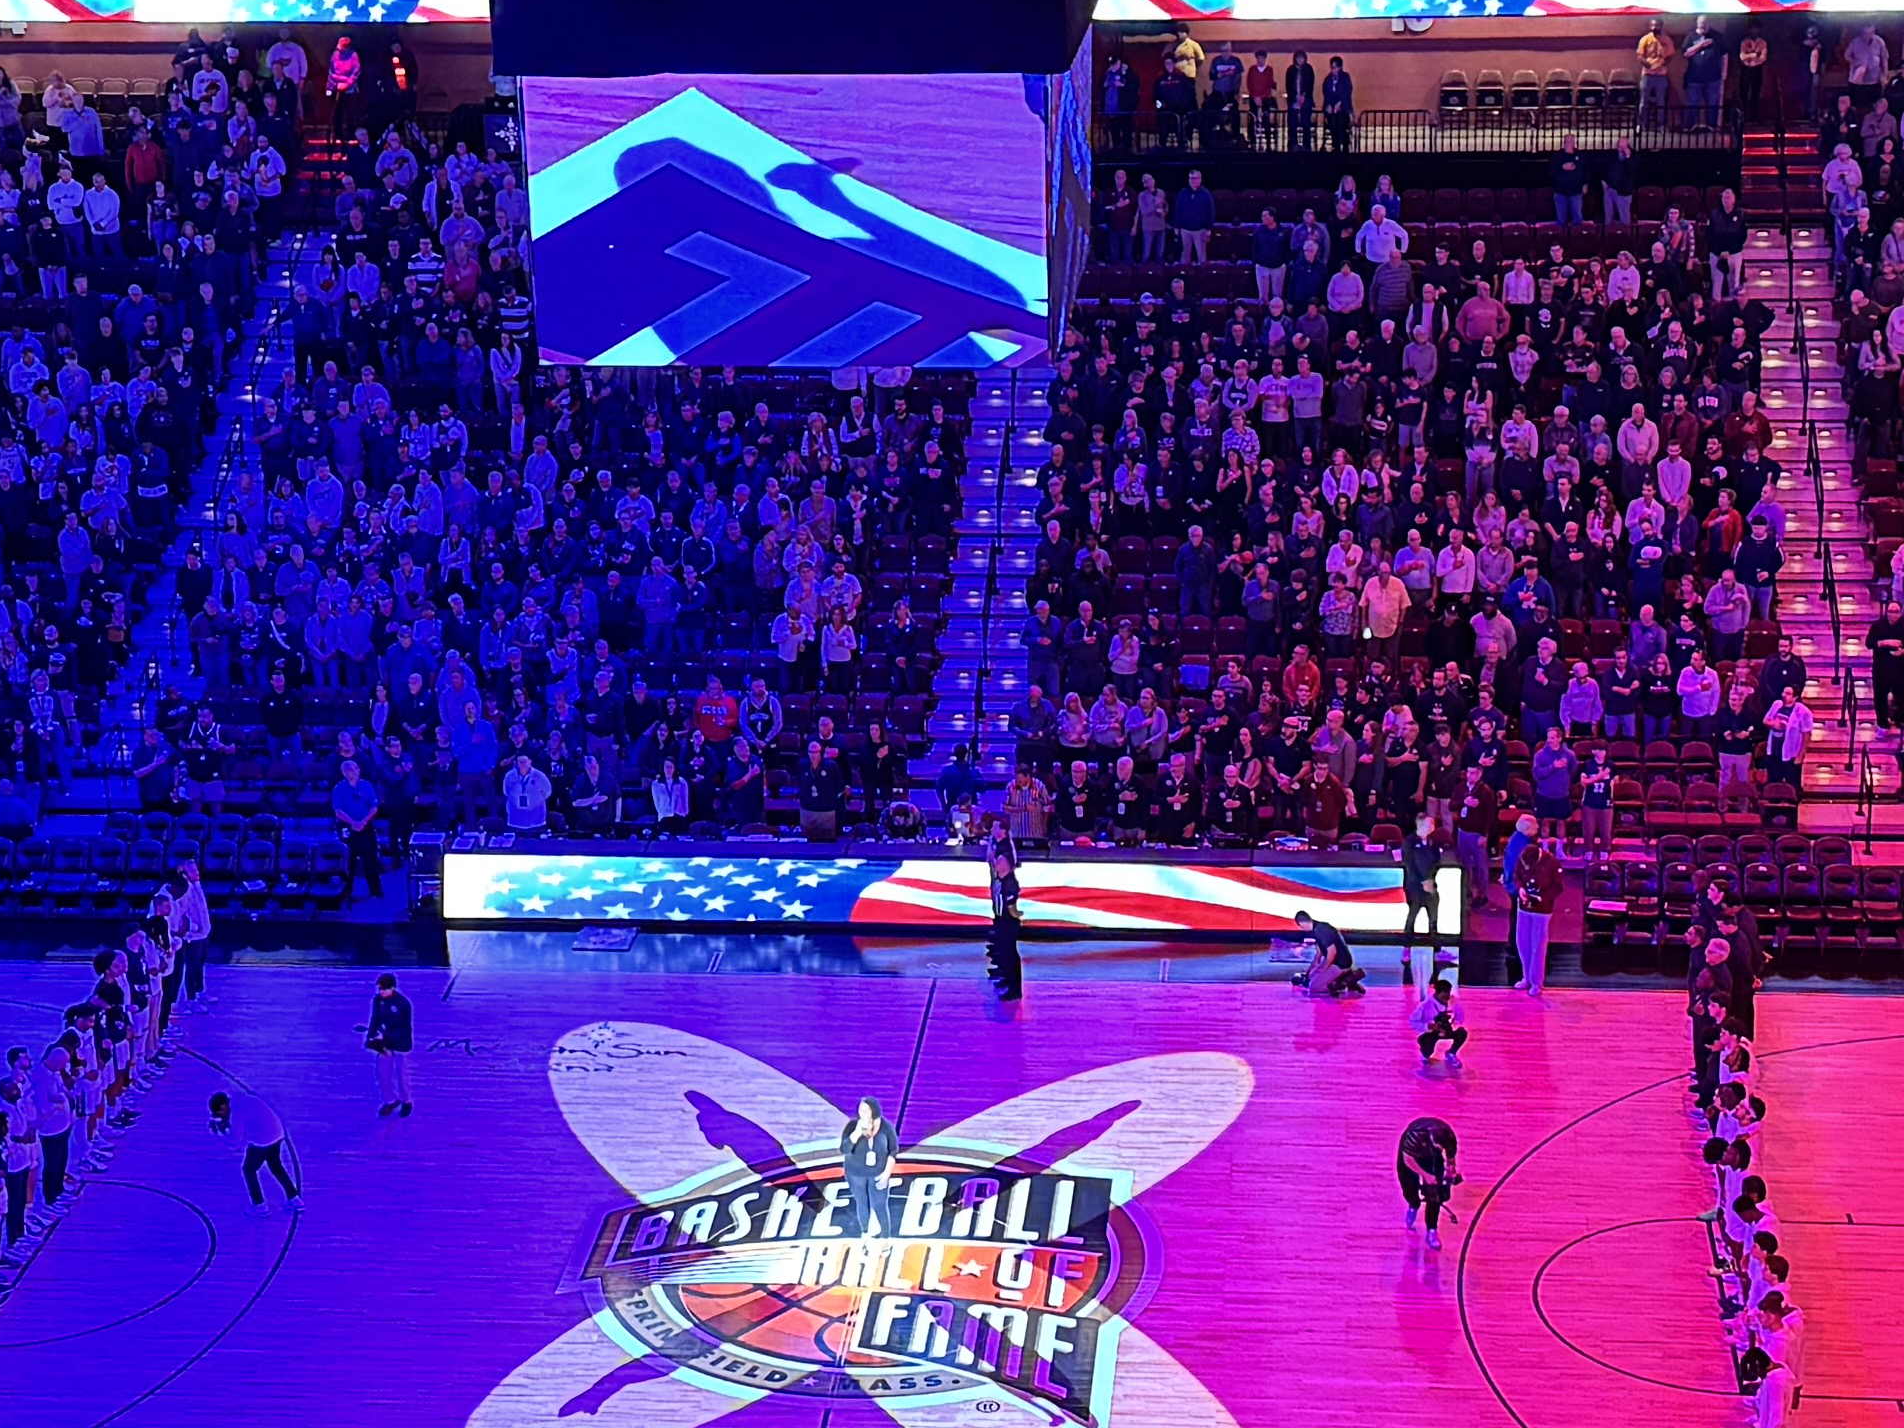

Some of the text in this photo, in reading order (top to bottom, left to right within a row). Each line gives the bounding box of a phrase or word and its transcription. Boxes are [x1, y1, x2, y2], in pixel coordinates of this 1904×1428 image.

[799, 1244, 1085, 1310] HALL OF
[868, 1293, 1078, 1401] FAME
